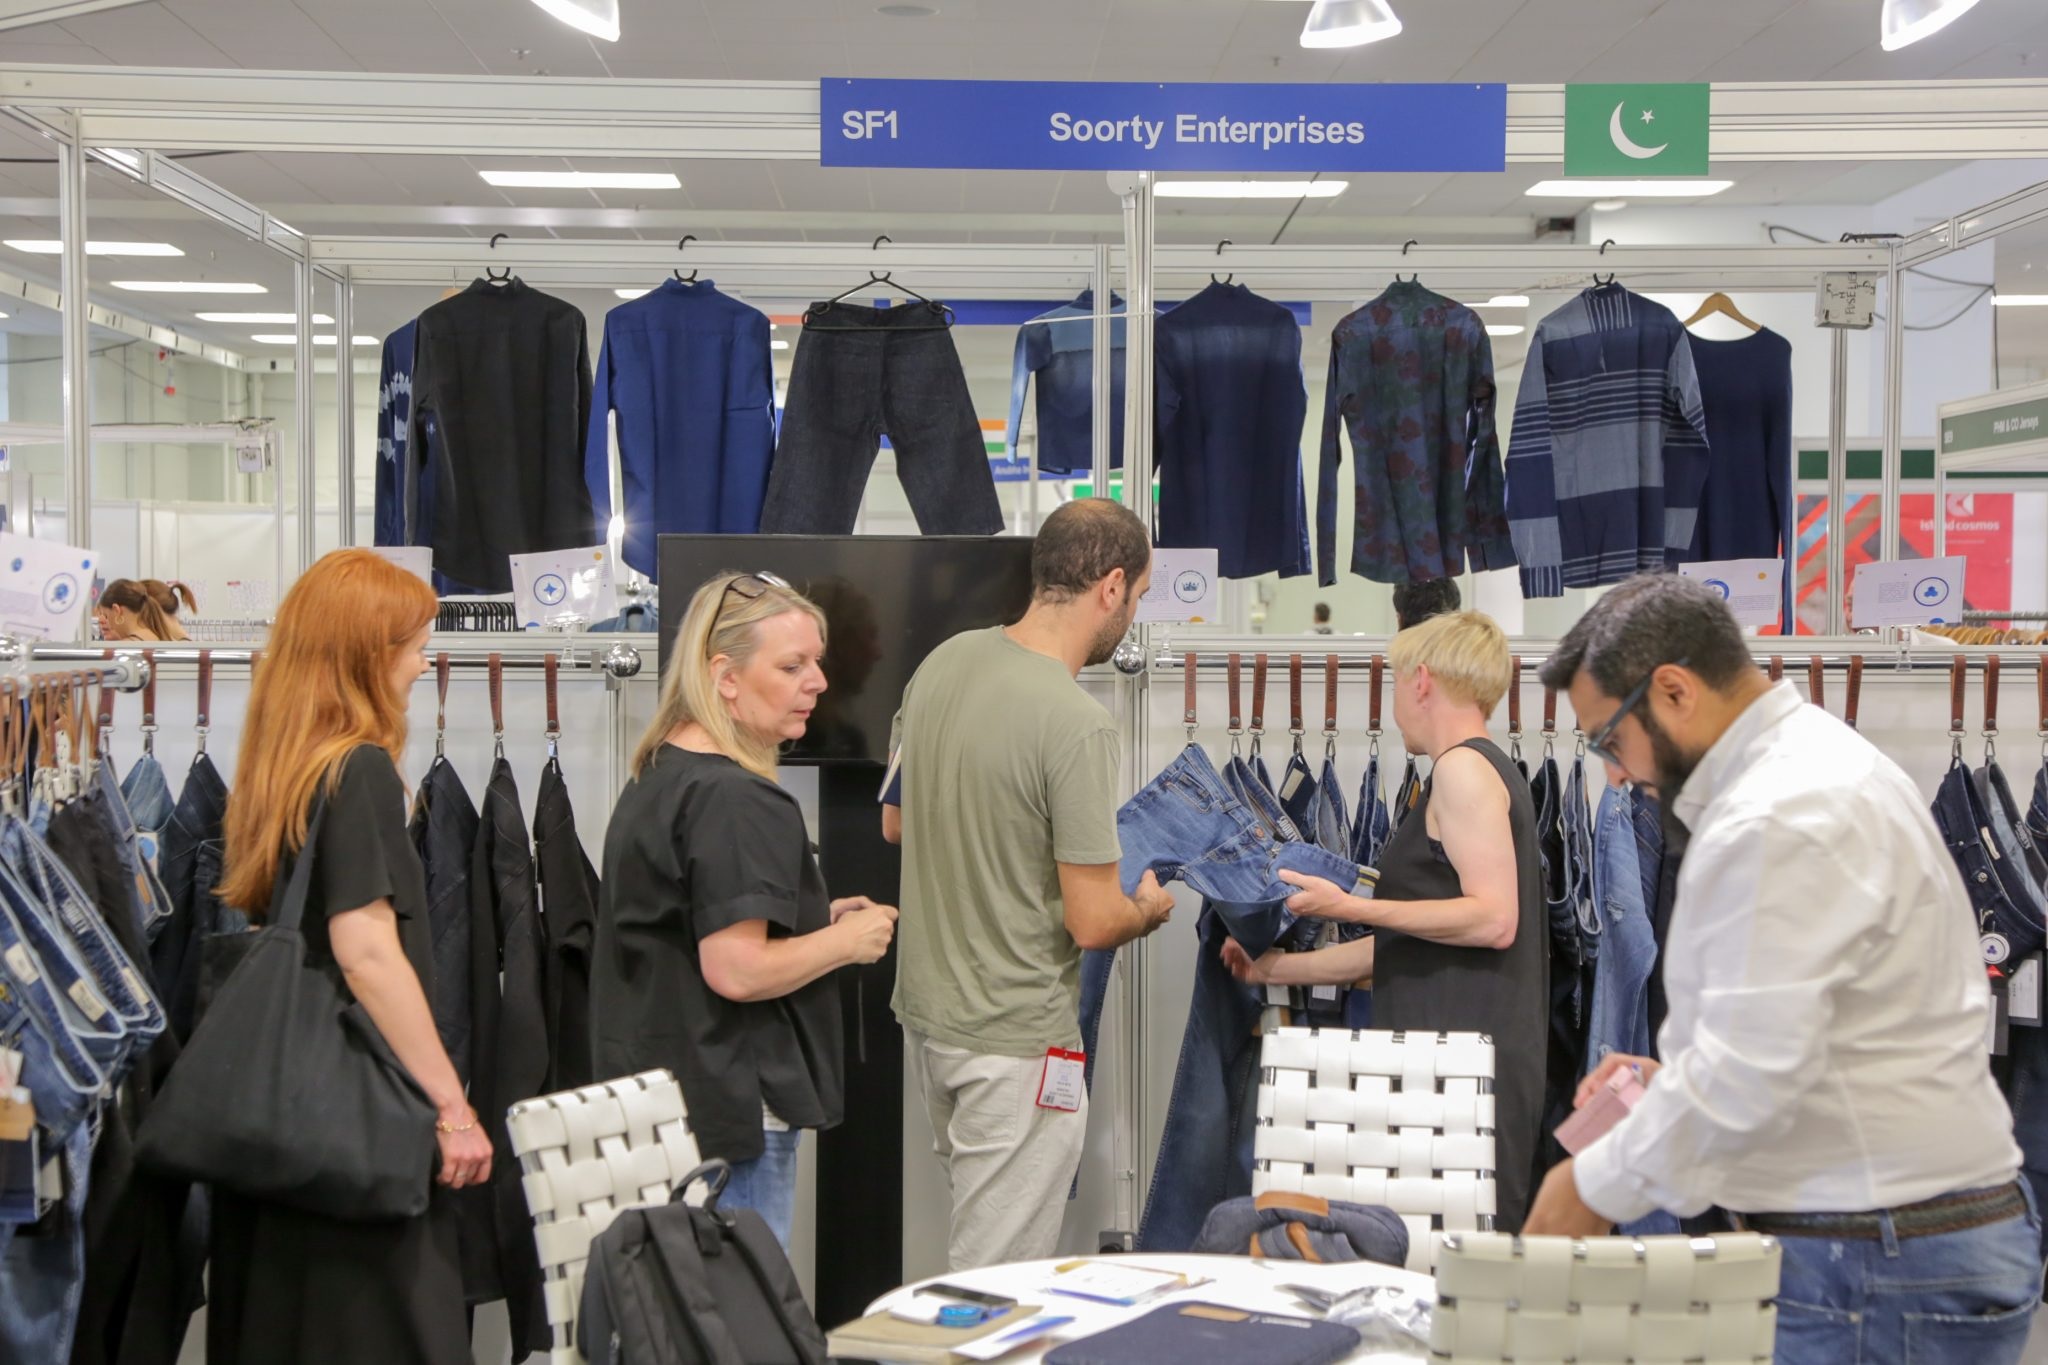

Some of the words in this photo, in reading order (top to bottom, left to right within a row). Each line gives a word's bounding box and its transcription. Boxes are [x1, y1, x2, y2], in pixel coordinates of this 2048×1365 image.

[842, 110, 899, 140] SF1
[1049, 112, 1164, 150] Soorty
[1175, 114, 1366, 151] Enterprises
